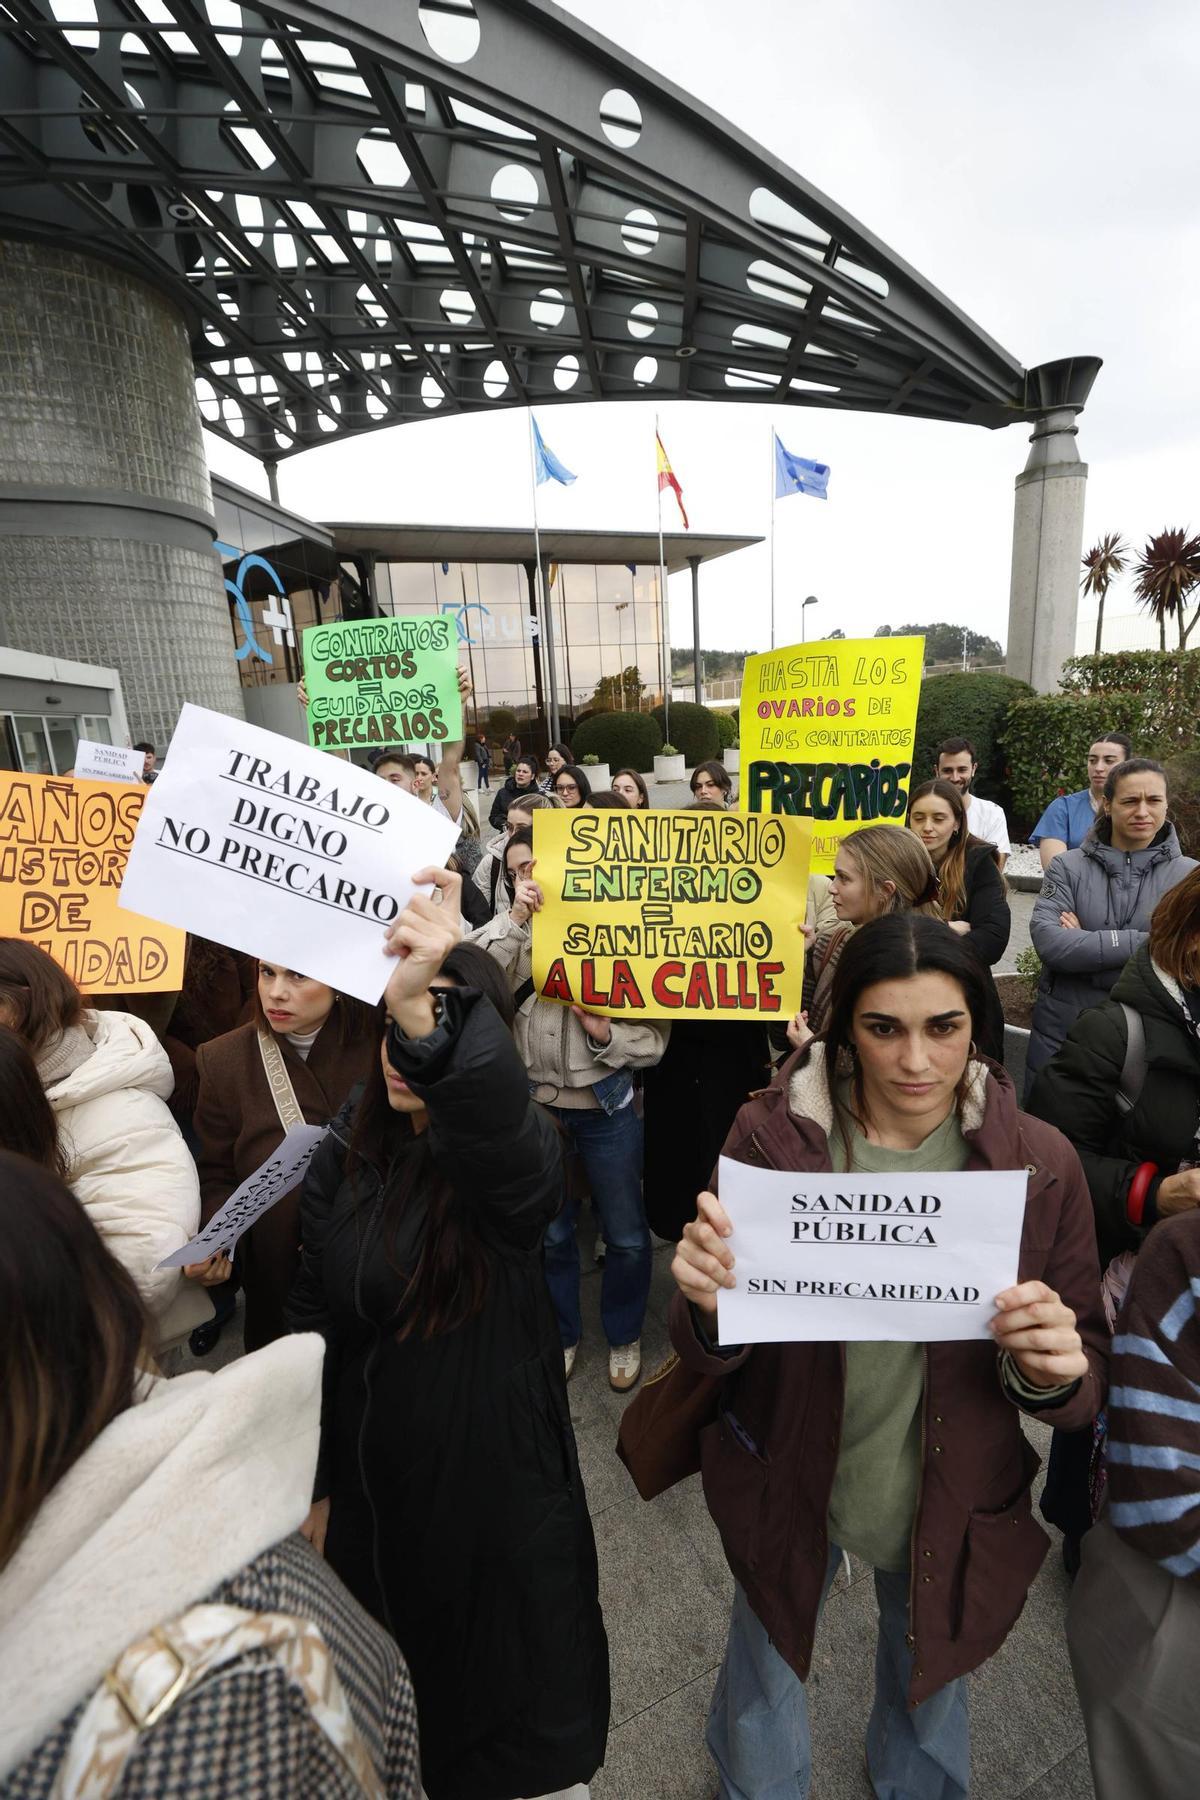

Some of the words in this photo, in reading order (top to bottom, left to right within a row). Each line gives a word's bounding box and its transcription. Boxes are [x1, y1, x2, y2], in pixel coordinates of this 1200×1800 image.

[311, 620, 449, 661] CONTRATOS
[325, 650, 417, 682] CORTOS
[759, 656, 839, 693] HASTA
[853, 657, 907, 686] LOS
[312, 684, 439, 718] CUIDADOS
[868, 697, 891, 715] DE
[312, 708, 449, 746] PRECARIOS
[761, 728, 800, 750] LOS
[805, 729, 912, 747] CONTRATOS
[226, 749, 390, 827] TRABAJO
[233, 797, 347, 857] DIGNO
[566, 815, 785, 867] SANITARIO
[158, 817, 210, 854] NO
[219, 837, 398, 921] PRECARIO
[561, 865, 762, 903] ENFERMO
[20, 891, 91, 933] DE
[563, 921, 773, 959] SANITARIO
[541, 957, 574, 1002] A
[581, 958, 646, 1009] LA
[651, 961, 785, 1012] CALLE
[197, 1160, 282, 1245] TRABAJO
[225, 1172, 283, 1230] DIGNO
[791, 1193, 941, 1214] SANIDAD
[792, 1216, 937, 1244] PÚBLICA
[748, 1278, 787, 1293] SIN
[795, 1280, 980, 1303] PRECARIEDAD
